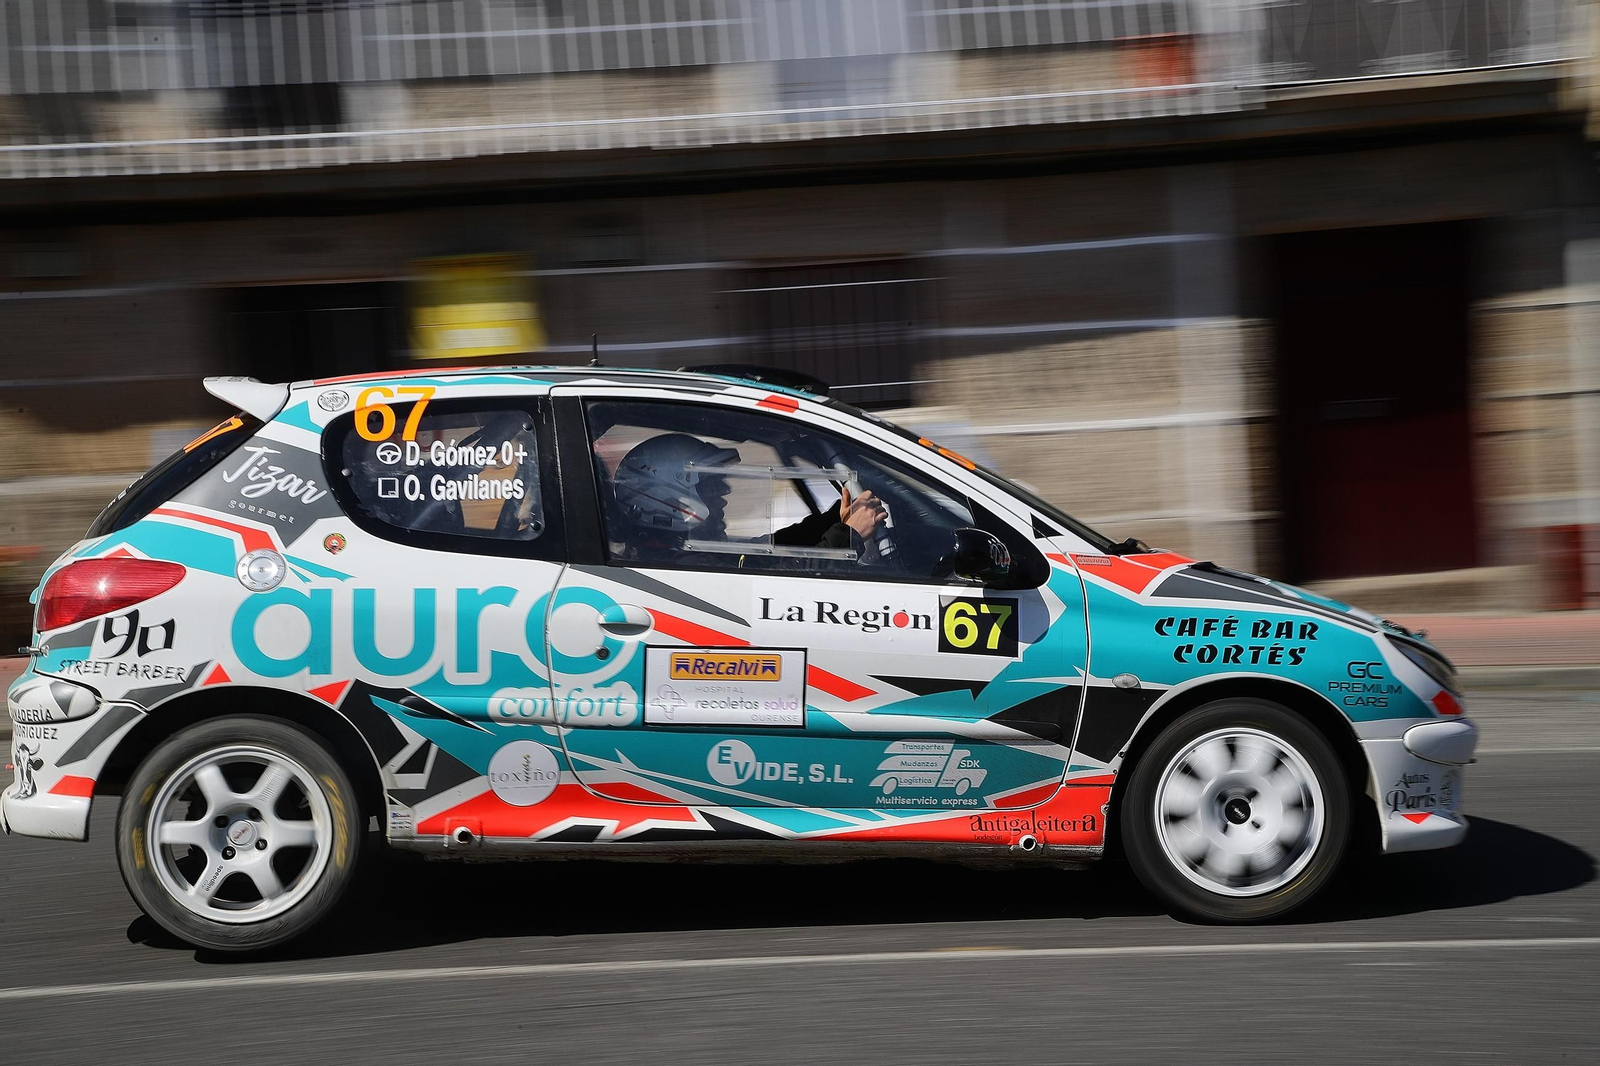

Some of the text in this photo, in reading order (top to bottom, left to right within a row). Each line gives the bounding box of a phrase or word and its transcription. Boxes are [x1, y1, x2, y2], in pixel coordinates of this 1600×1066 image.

[353, 386, 436, 441] 67
[405, 441, 425, 466] D.
[430, 439, 497, 467] Gómez
[403, 474, 525, 501] O. Gavilanes
[228, 499, 295, 524] gourmet
[758, 597, 933, 633] La Región
[231, 586, 625, 678] auro
[943, 601, 1012, 650] 67
[1154, 615, 1320, 641] CAFÉ BAR
[1172, 643, 1308, 666] CORTÉS
[59, 659, 187, 684] STREET BARBER
[691, 657, 761, 677] Recalvi
[1346, 661, 1385, 681] GC
[694, 686, 746, 695] HOSPITAL
[1327, 681, 1404, 696] PREMIUM
[694, 697, 799, 711] recoletas salud
[1343, 695, 1390, 708] CARS
[751, 714, 799, 723] OURENSE
[901, 743, 946, 752] Transportes
[808, 763, 855, 784] S.L.
[900, 760, 939, 768] Mudanzas
[960, 760, 981, 769] SDK
[899, 776, 932, 786] Logística
[875, 795, 978, 808] Multiservicio express
